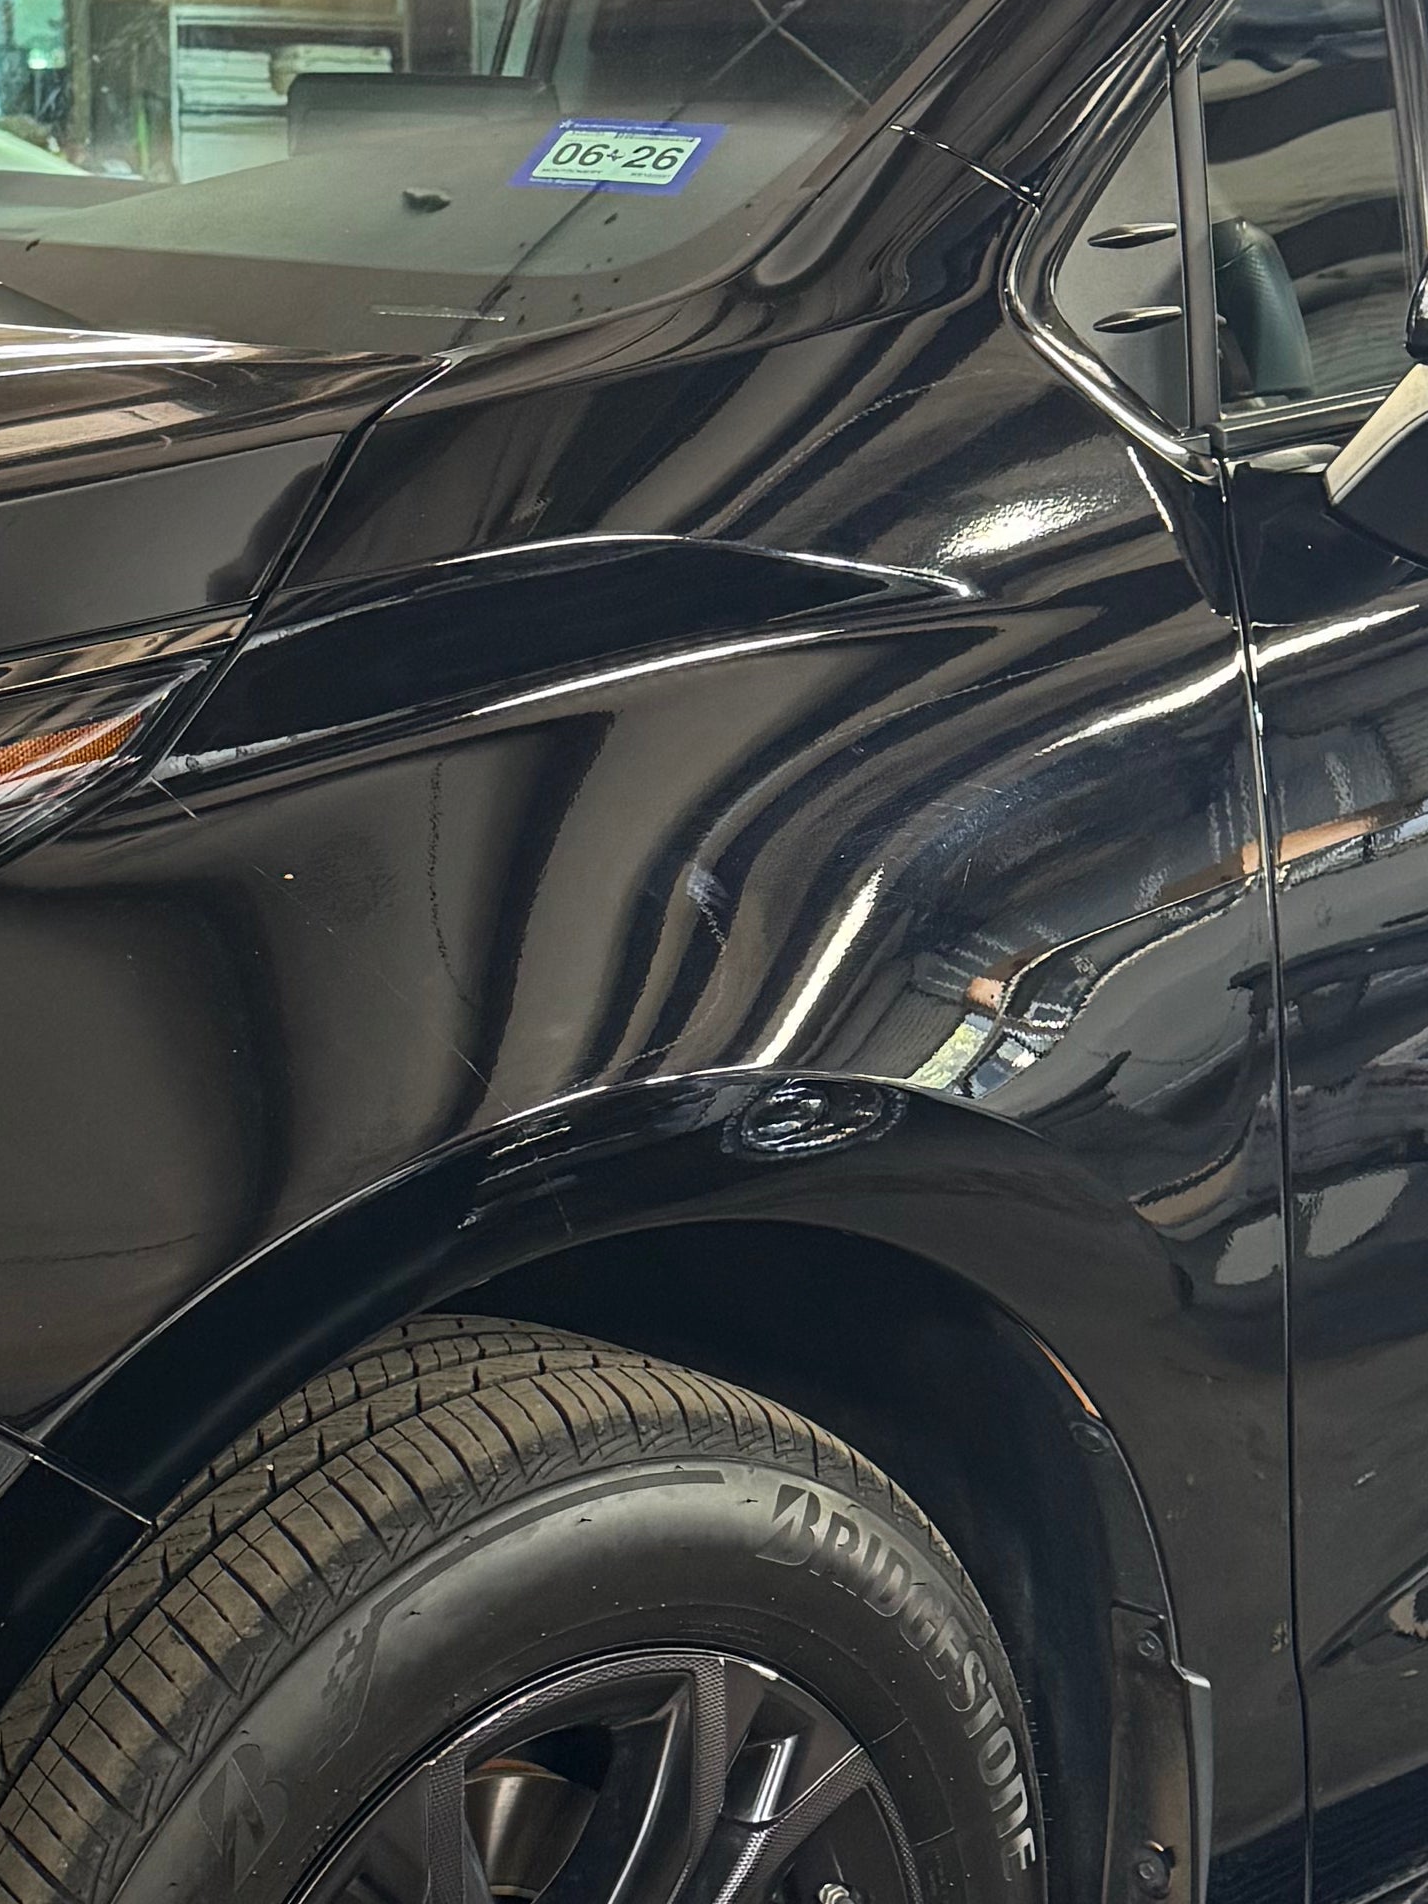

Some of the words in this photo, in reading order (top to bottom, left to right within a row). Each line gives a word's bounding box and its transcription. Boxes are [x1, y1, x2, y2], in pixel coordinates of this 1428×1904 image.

[552, 142, 609, 166] 06
[621, 146, 685, 171] 26
[755, 1483, 1036, 1883] BRIDGESTONE
